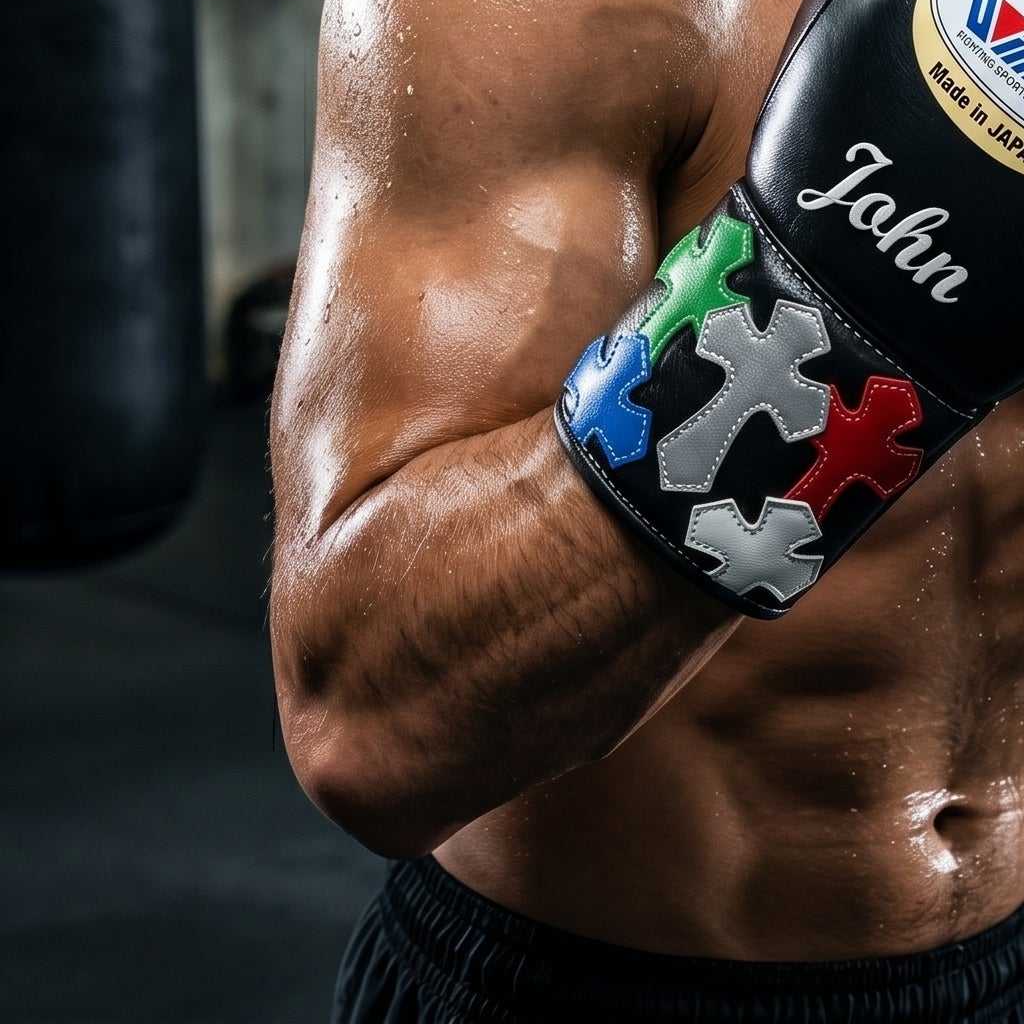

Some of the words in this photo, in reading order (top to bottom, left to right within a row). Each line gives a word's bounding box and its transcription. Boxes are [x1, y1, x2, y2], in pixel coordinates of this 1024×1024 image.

[928, 61, 970, 110] Made
[969, 102, 989, 126] in
[797, 142, 969, 304] John
